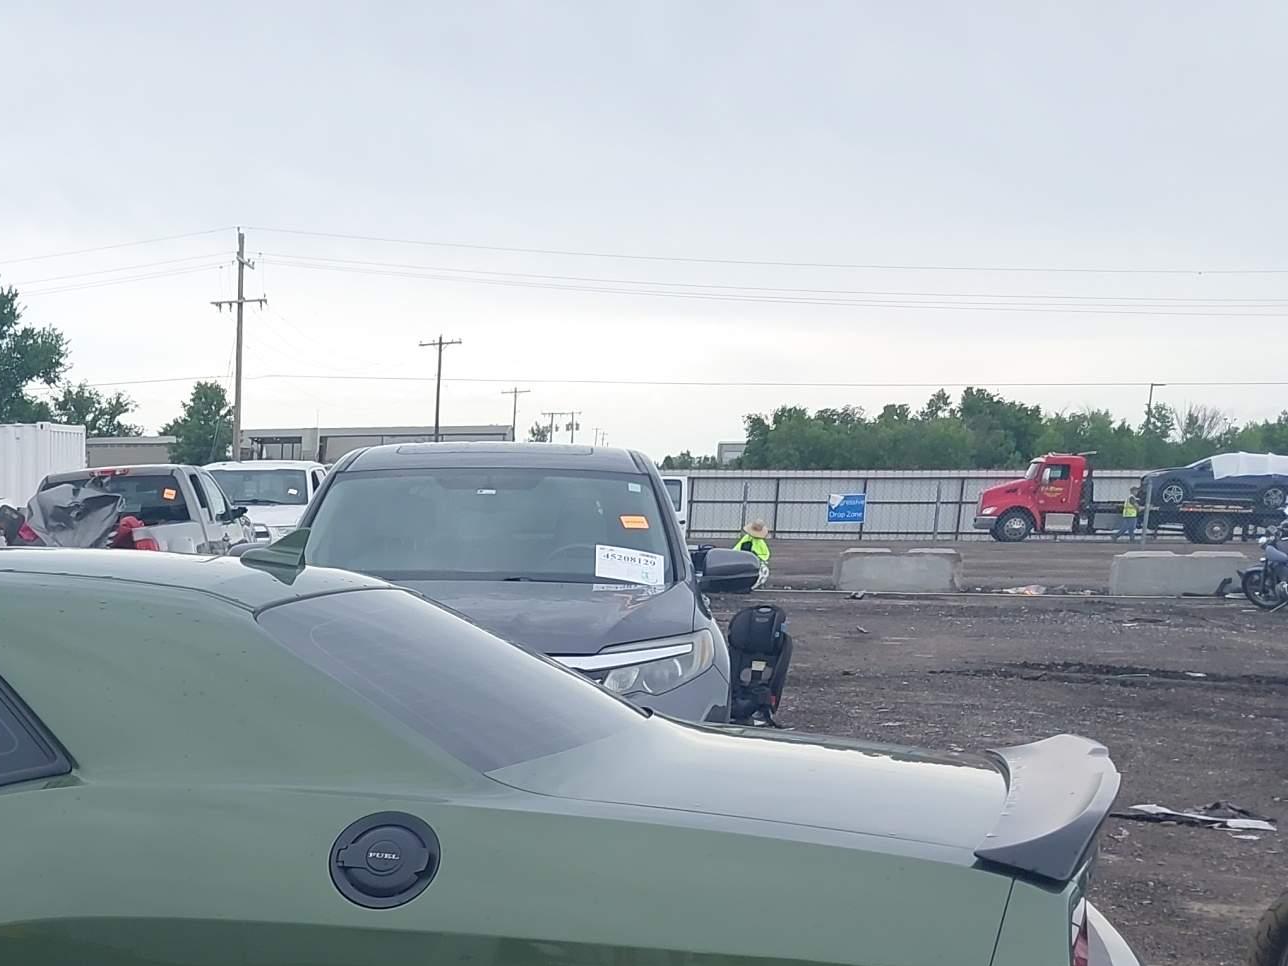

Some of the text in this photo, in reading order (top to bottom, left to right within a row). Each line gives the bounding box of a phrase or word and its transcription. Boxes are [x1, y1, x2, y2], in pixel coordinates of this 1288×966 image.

[829, 510, 863, 519] Drop Zone
[367, 852, 400, 860] FUEL
